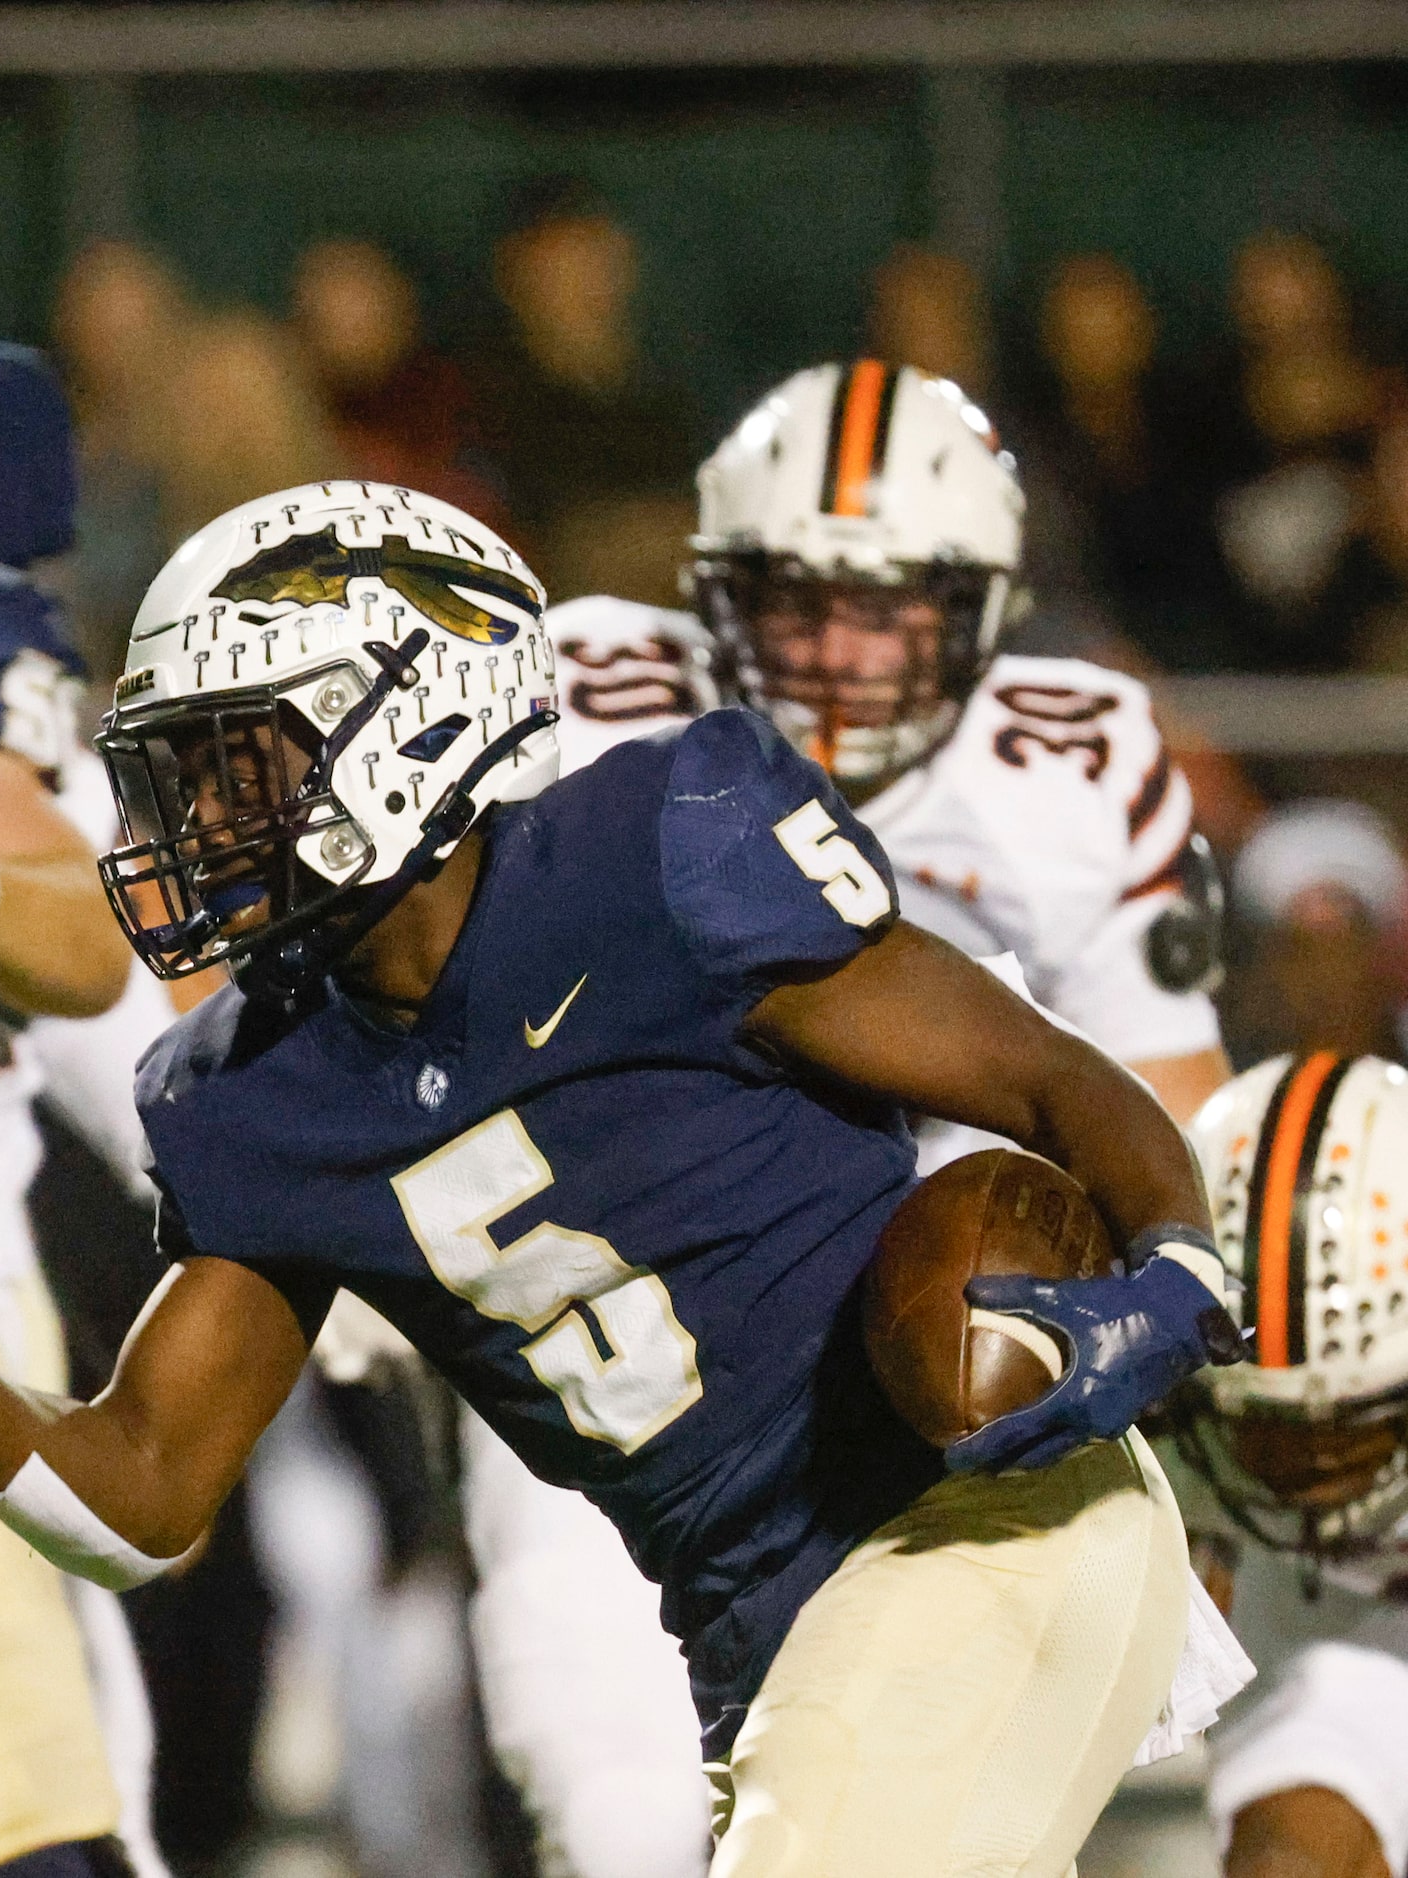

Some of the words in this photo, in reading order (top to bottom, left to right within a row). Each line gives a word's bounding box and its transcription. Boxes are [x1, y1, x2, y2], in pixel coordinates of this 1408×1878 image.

[994, 684, 1121, 784] 30
[772, 797, 891, 929] 5
[389, 1108, 704, 1456] 5
